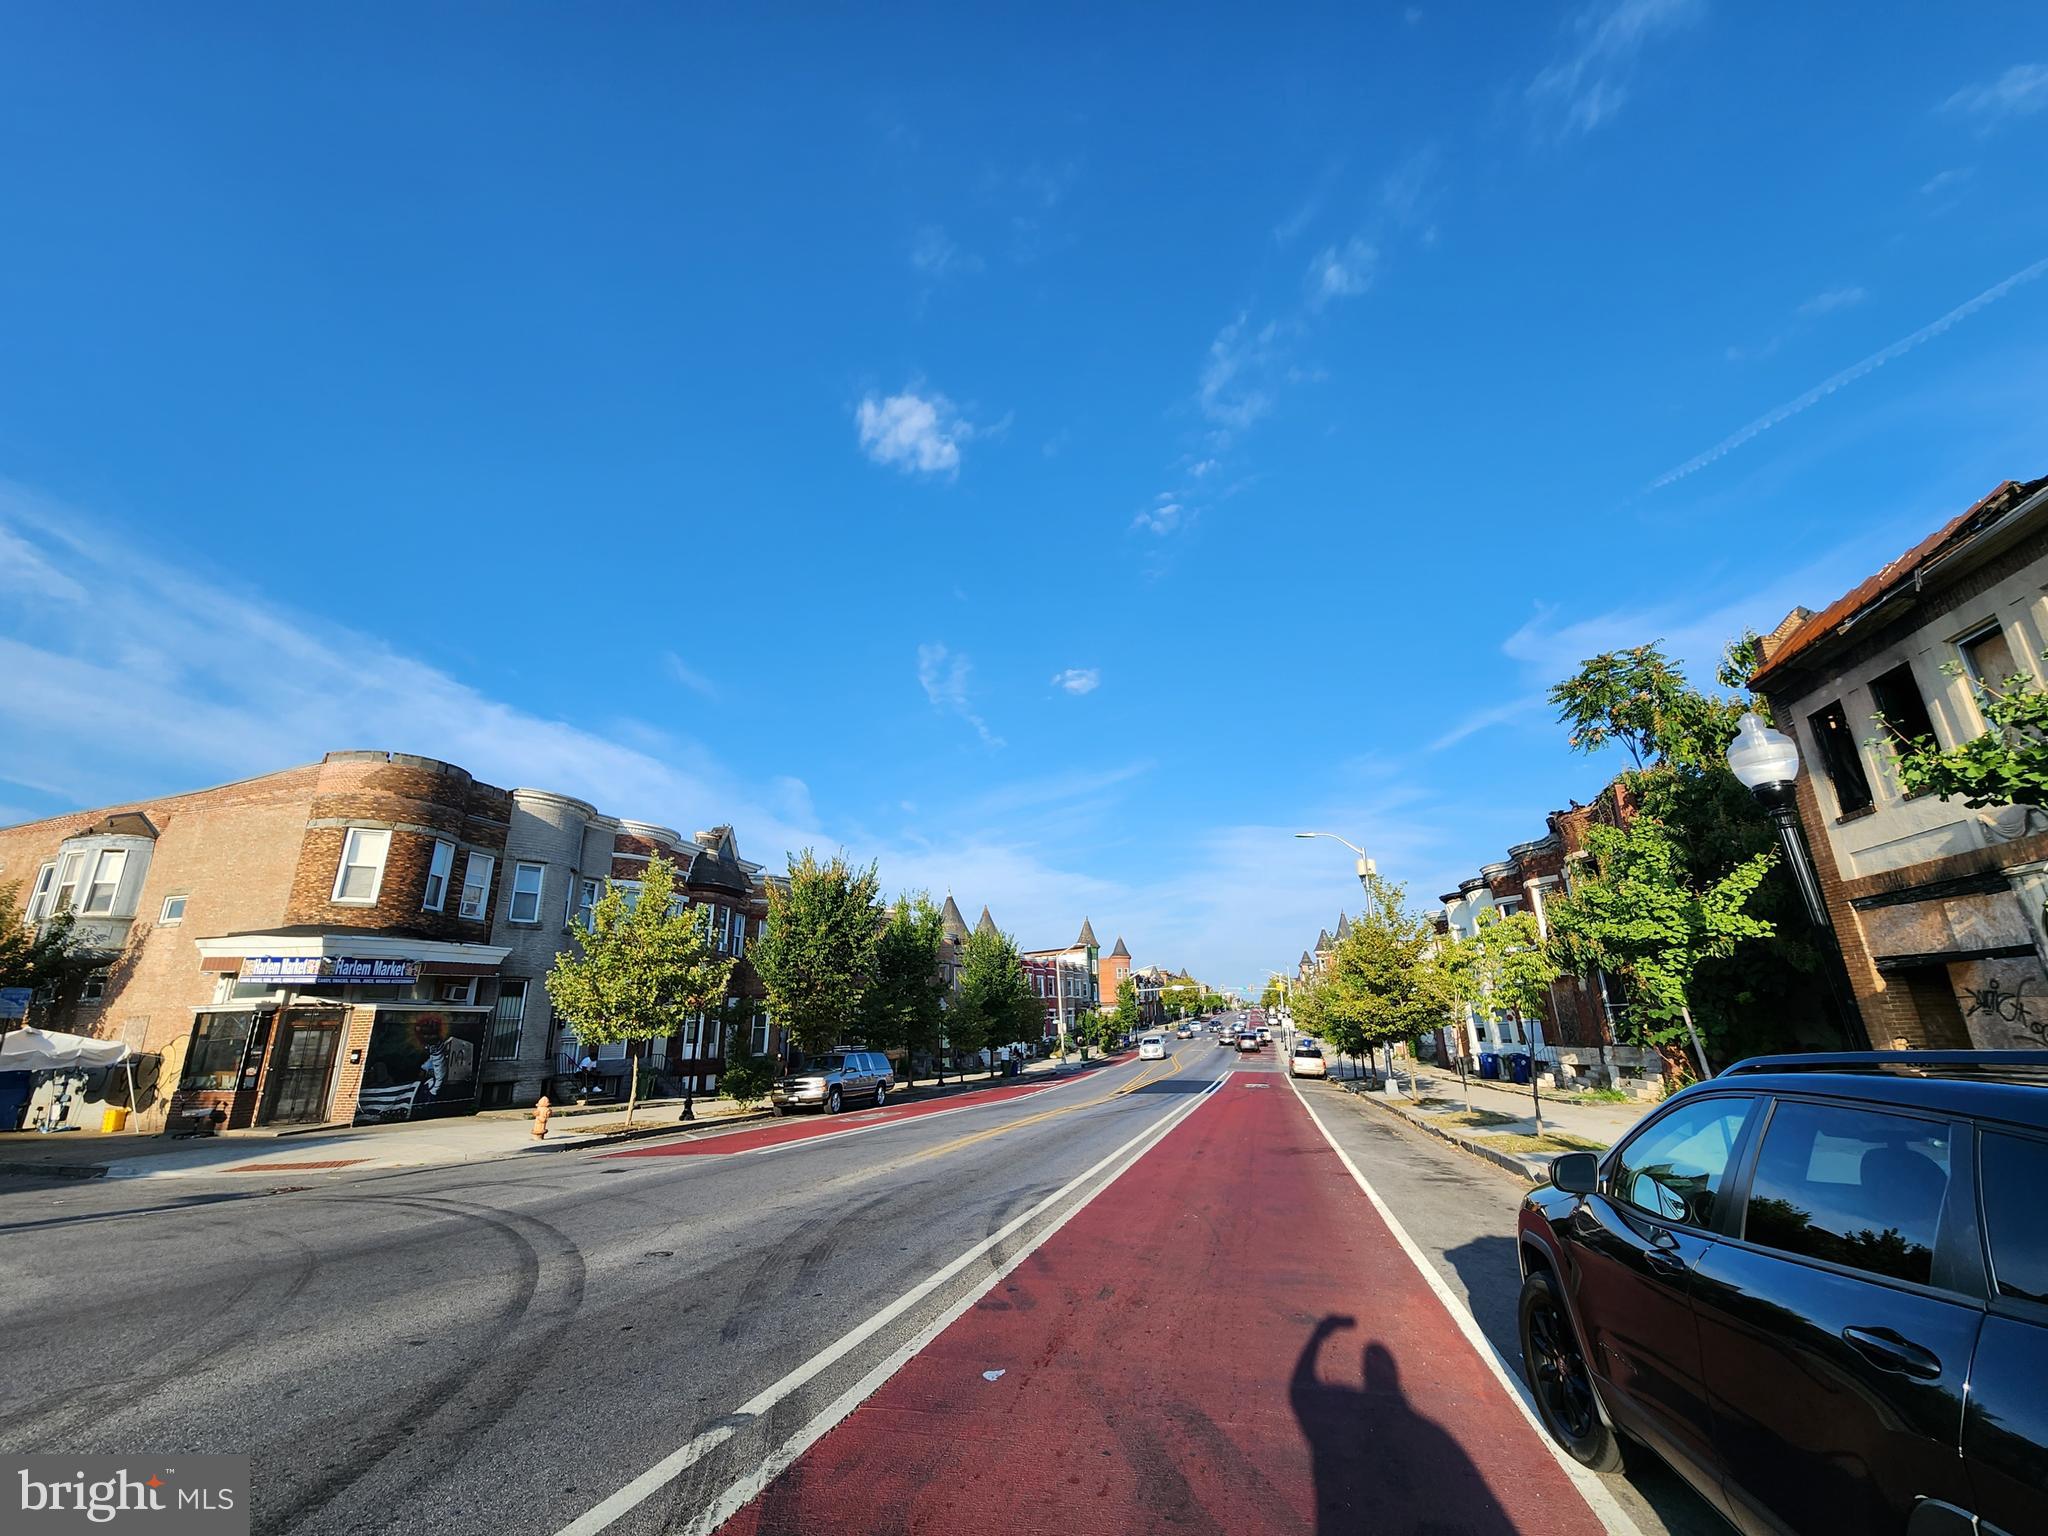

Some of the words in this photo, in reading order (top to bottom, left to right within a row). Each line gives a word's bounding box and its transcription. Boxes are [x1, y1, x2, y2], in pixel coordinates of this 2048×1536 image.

[253, 958, 281, 975] Harlem
[281, 958, 308, 975] Market
[335, 960, 371, 976] Harlem
[372, 960, 406, 976] Market
